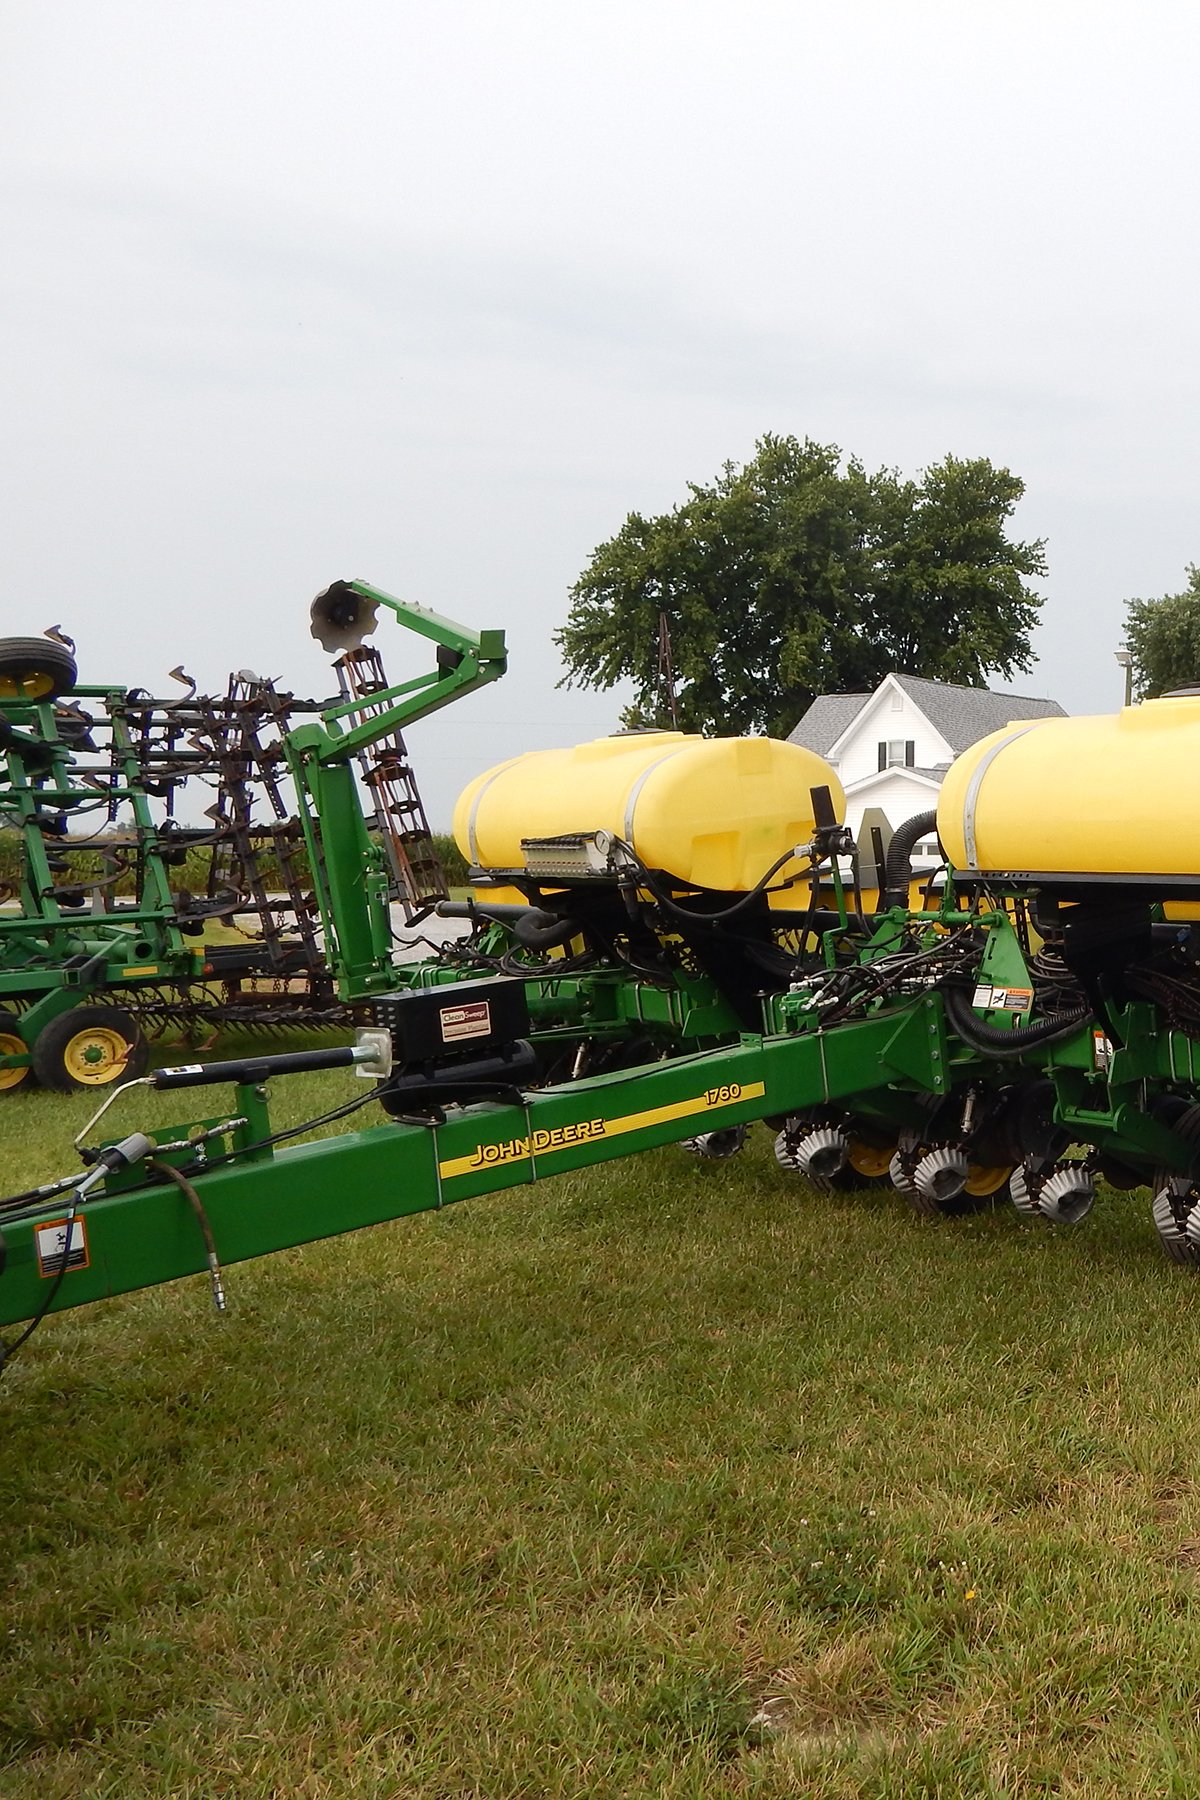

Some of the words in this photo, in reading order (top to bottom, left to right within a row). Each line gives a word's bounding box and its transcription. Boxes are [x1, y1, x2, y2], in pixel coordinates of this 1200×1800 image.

[704, 1083, 741, 1105] 1760
[470, 1136, 530, 1166] JOHN
[532, 1118, 604, 1150] DEERE
